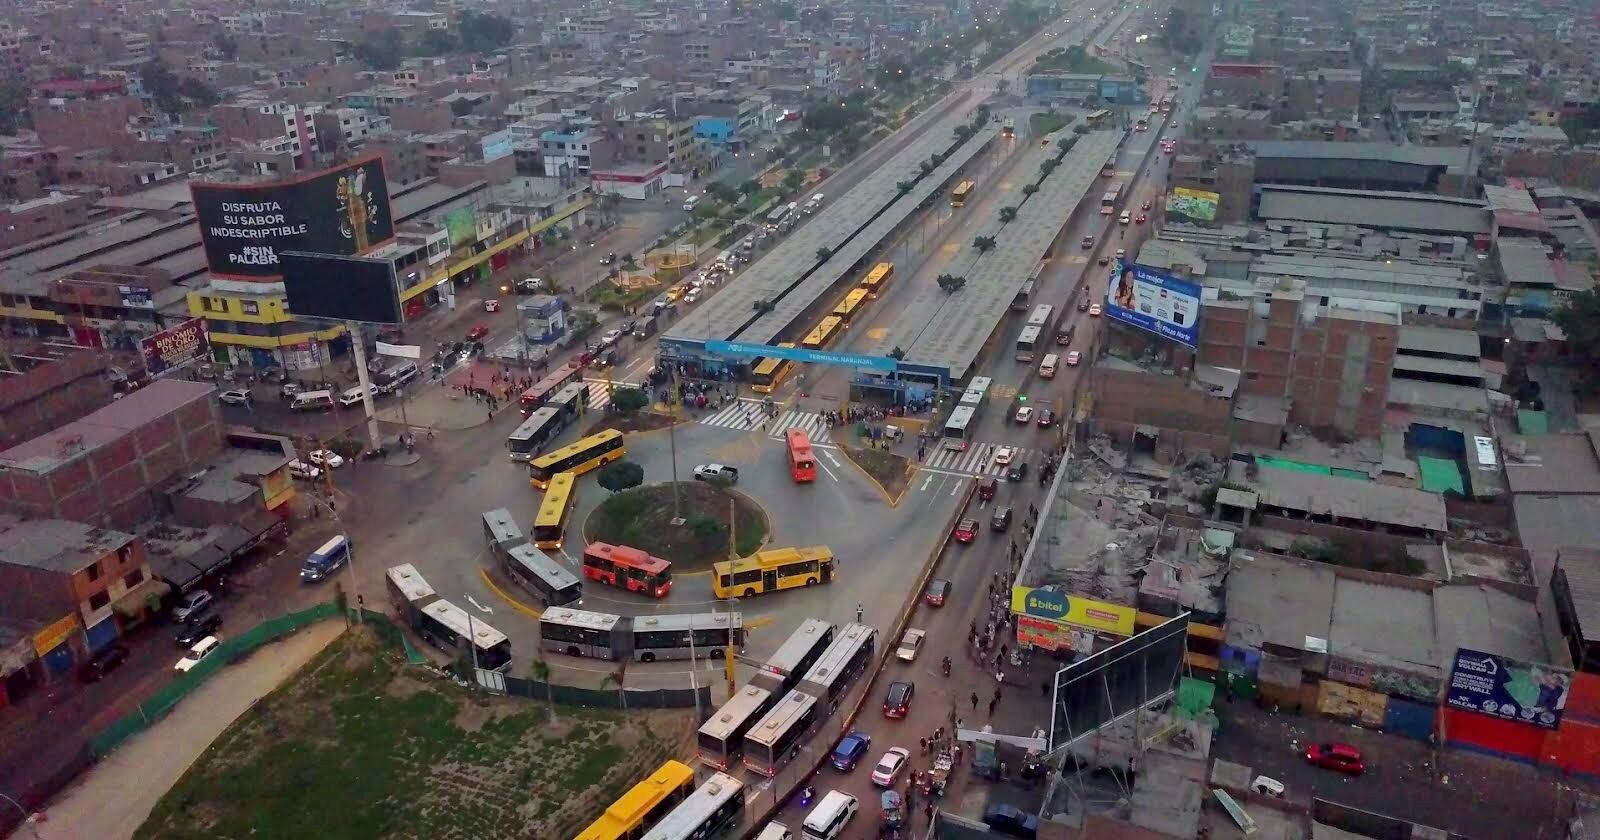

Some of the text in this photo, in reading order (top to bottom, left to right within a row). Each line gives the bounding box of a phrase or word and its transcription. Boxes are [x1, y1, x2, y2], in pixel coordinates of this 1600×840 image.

[222, 202, 281, 212] DISFRUTA
[224, 214, 285, 226] SU SABOR
[210, 224, 307, 238] INDESCRIPTIBLE
[242, 246, 274, 257] #SIN
[229, 254, 280, 265] PALABR
[1137, 270, 1164, 284] La mejor
[156, 327, 197, 349] BINOMIO
[176, 334, 196, 347] ORO
[1176, 330, 1191, 341] Norte
[809, 353, 873, 365] TERMINAL NARANJAL
[1038, 600, 1063, 612] bitel
[1452, 682, 1491, 695] DRYWALL
[1448, 698, 1478, 709] VOLCAN
